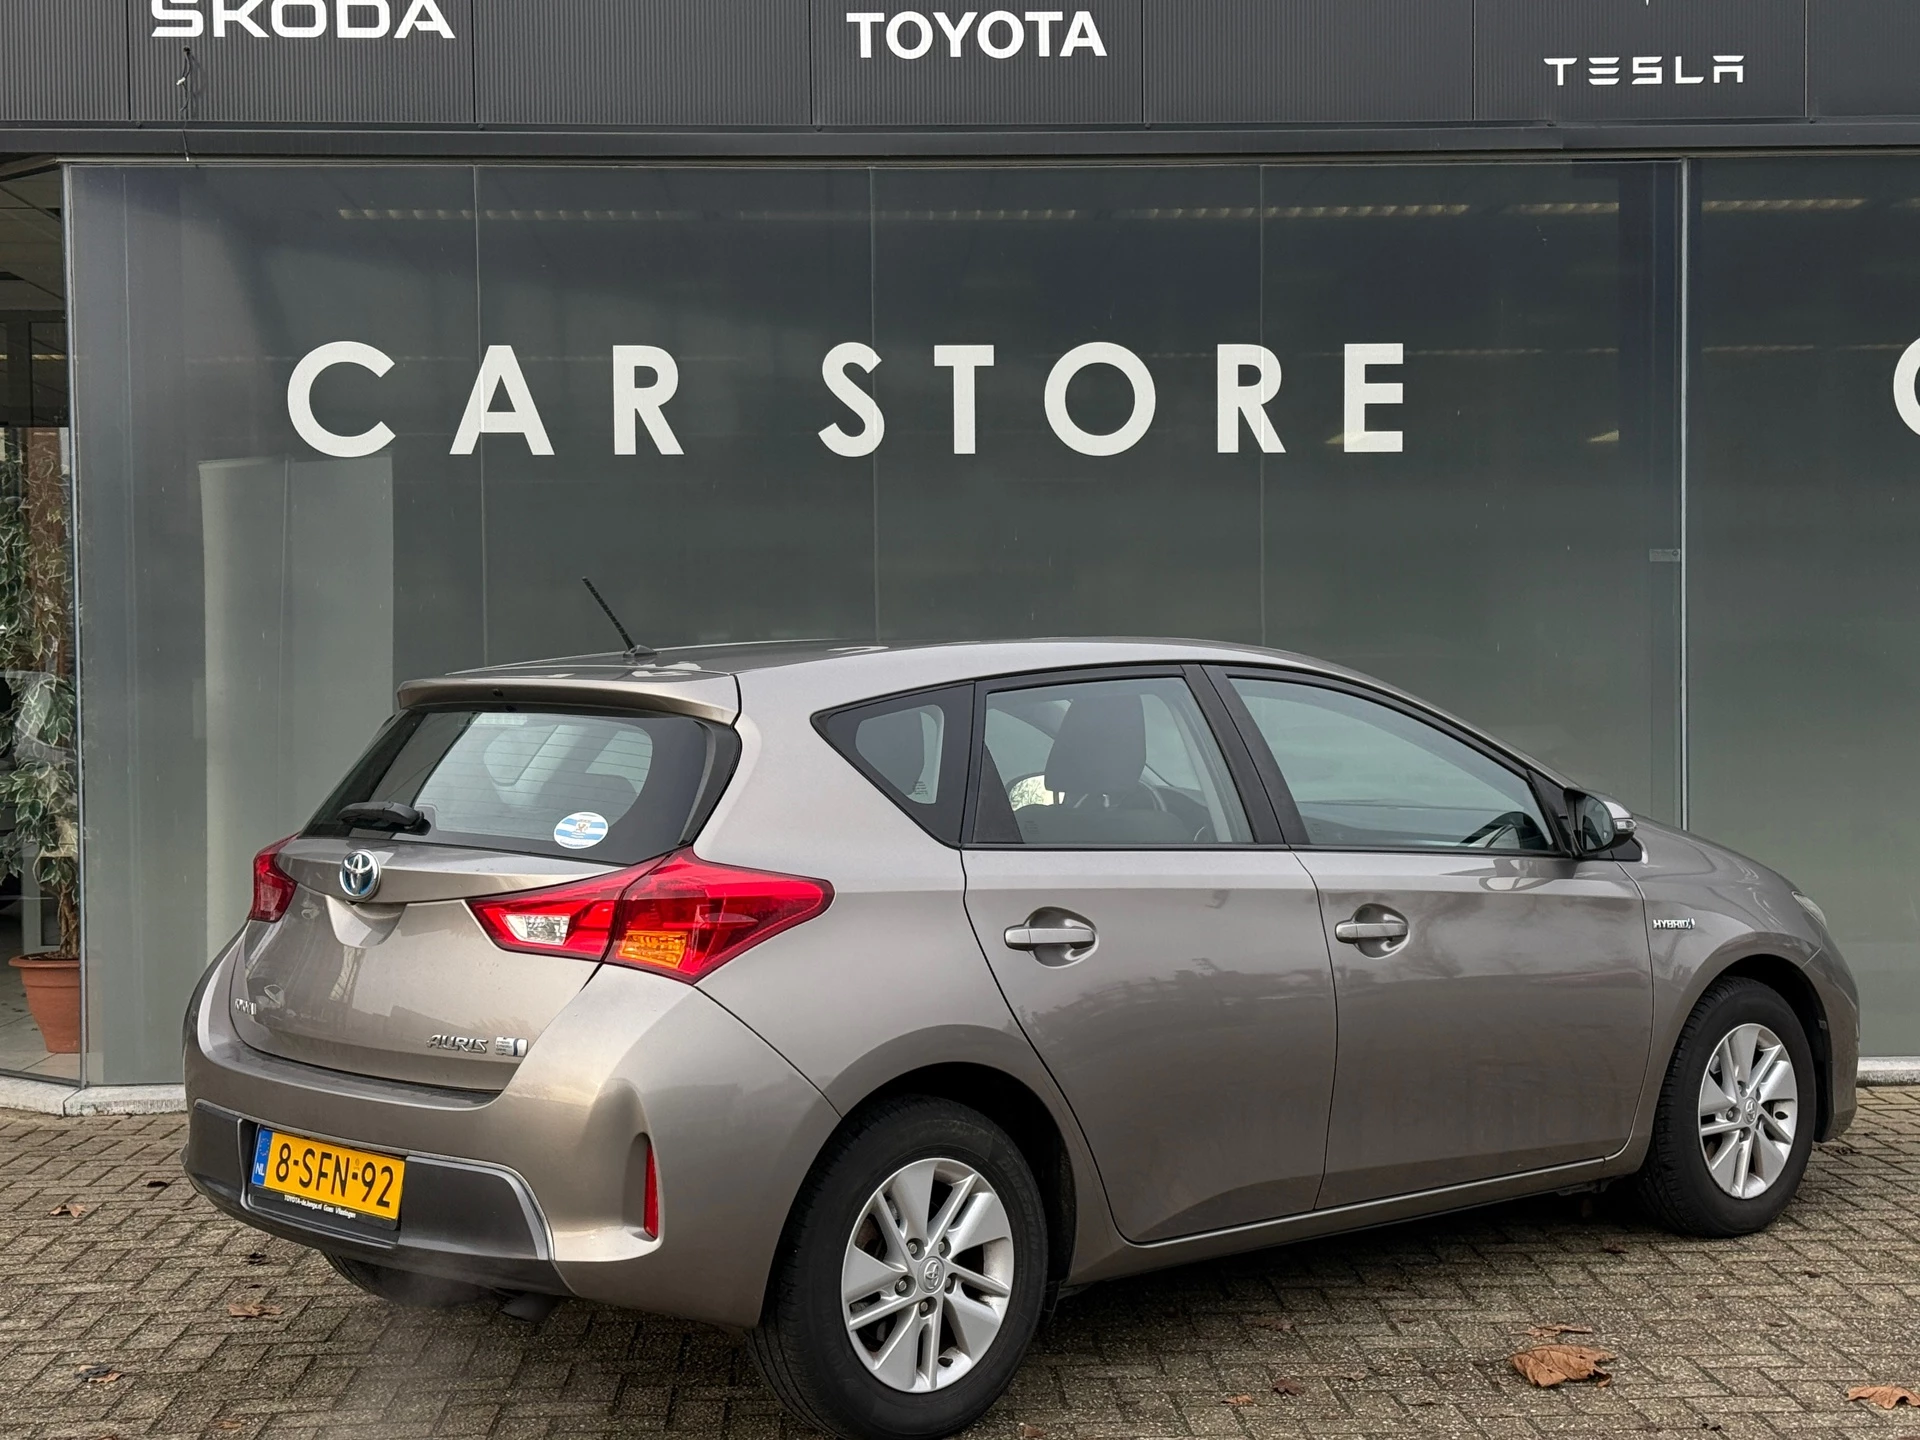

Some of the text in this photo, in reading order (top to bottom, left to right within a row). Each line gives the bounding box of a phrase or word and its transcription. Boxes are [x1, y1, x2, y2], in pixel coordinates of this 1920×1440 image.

[846, 11, 1108, 60] TOYOTA
[1544, 55, 1745, 86] TESLA
[287, 341, 1404, 458] CAR STORE
[1652, 919, 1690, 929] HYBRID
[426, 1034, 489, 1055] AURIS
[254, 1162, 265, 1177] NL
[276, 1143, 394, 1209] 8-SFN-92
